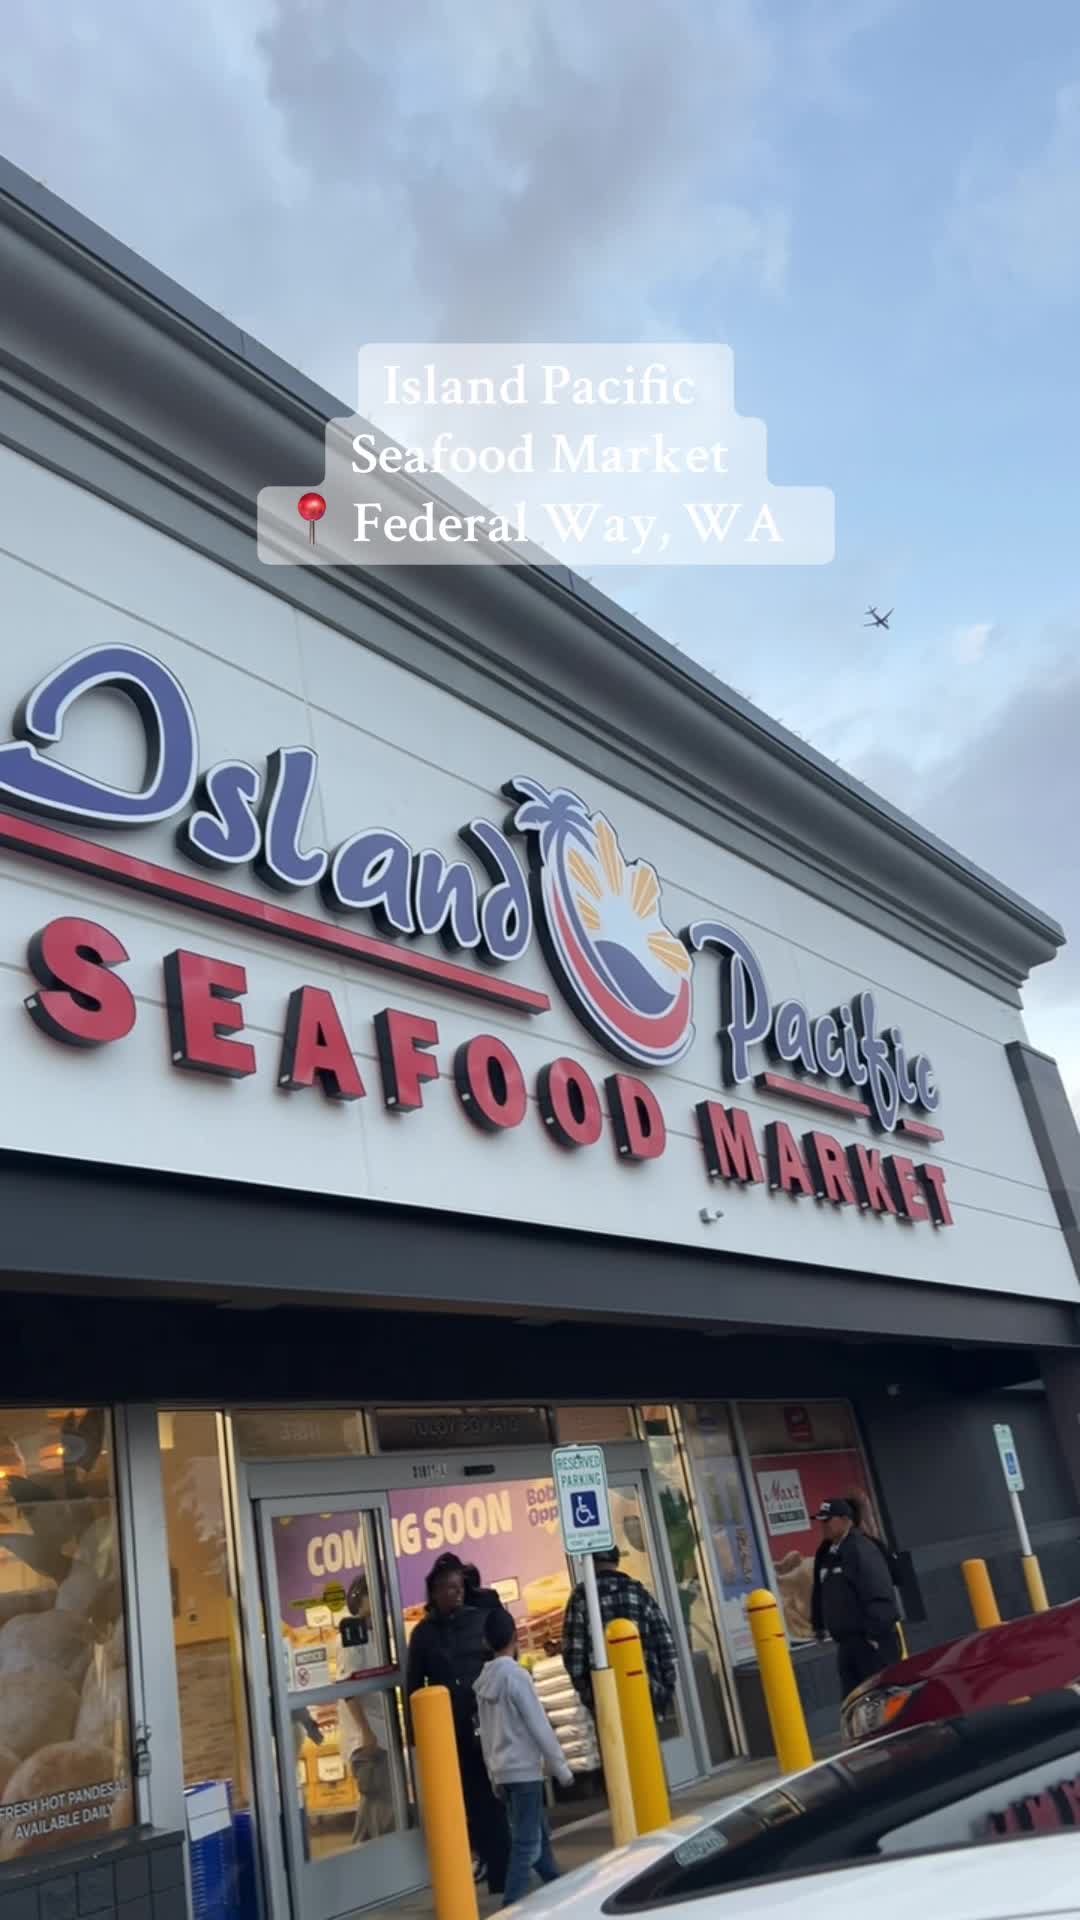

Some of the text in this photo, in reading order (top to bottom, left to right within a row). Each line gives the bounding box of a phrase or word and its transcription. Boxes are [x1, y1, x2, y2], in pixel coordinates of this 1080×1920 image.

[0, 641, 943, 1132] Island Pacific
[25, 916, 954, 1228] SEAFOOD MARKET
[557, 1455, 601, 1470] RESERVED
[561, 1472, 601, 1488] PARKING
[423, 1490, 513, 1550] SOON
[0, 1800, 38, 1819] FRESH
[40, 1792, 66, 1812] HOT
[15, 1802, 113, 1840] AVAILABLE DAILY
